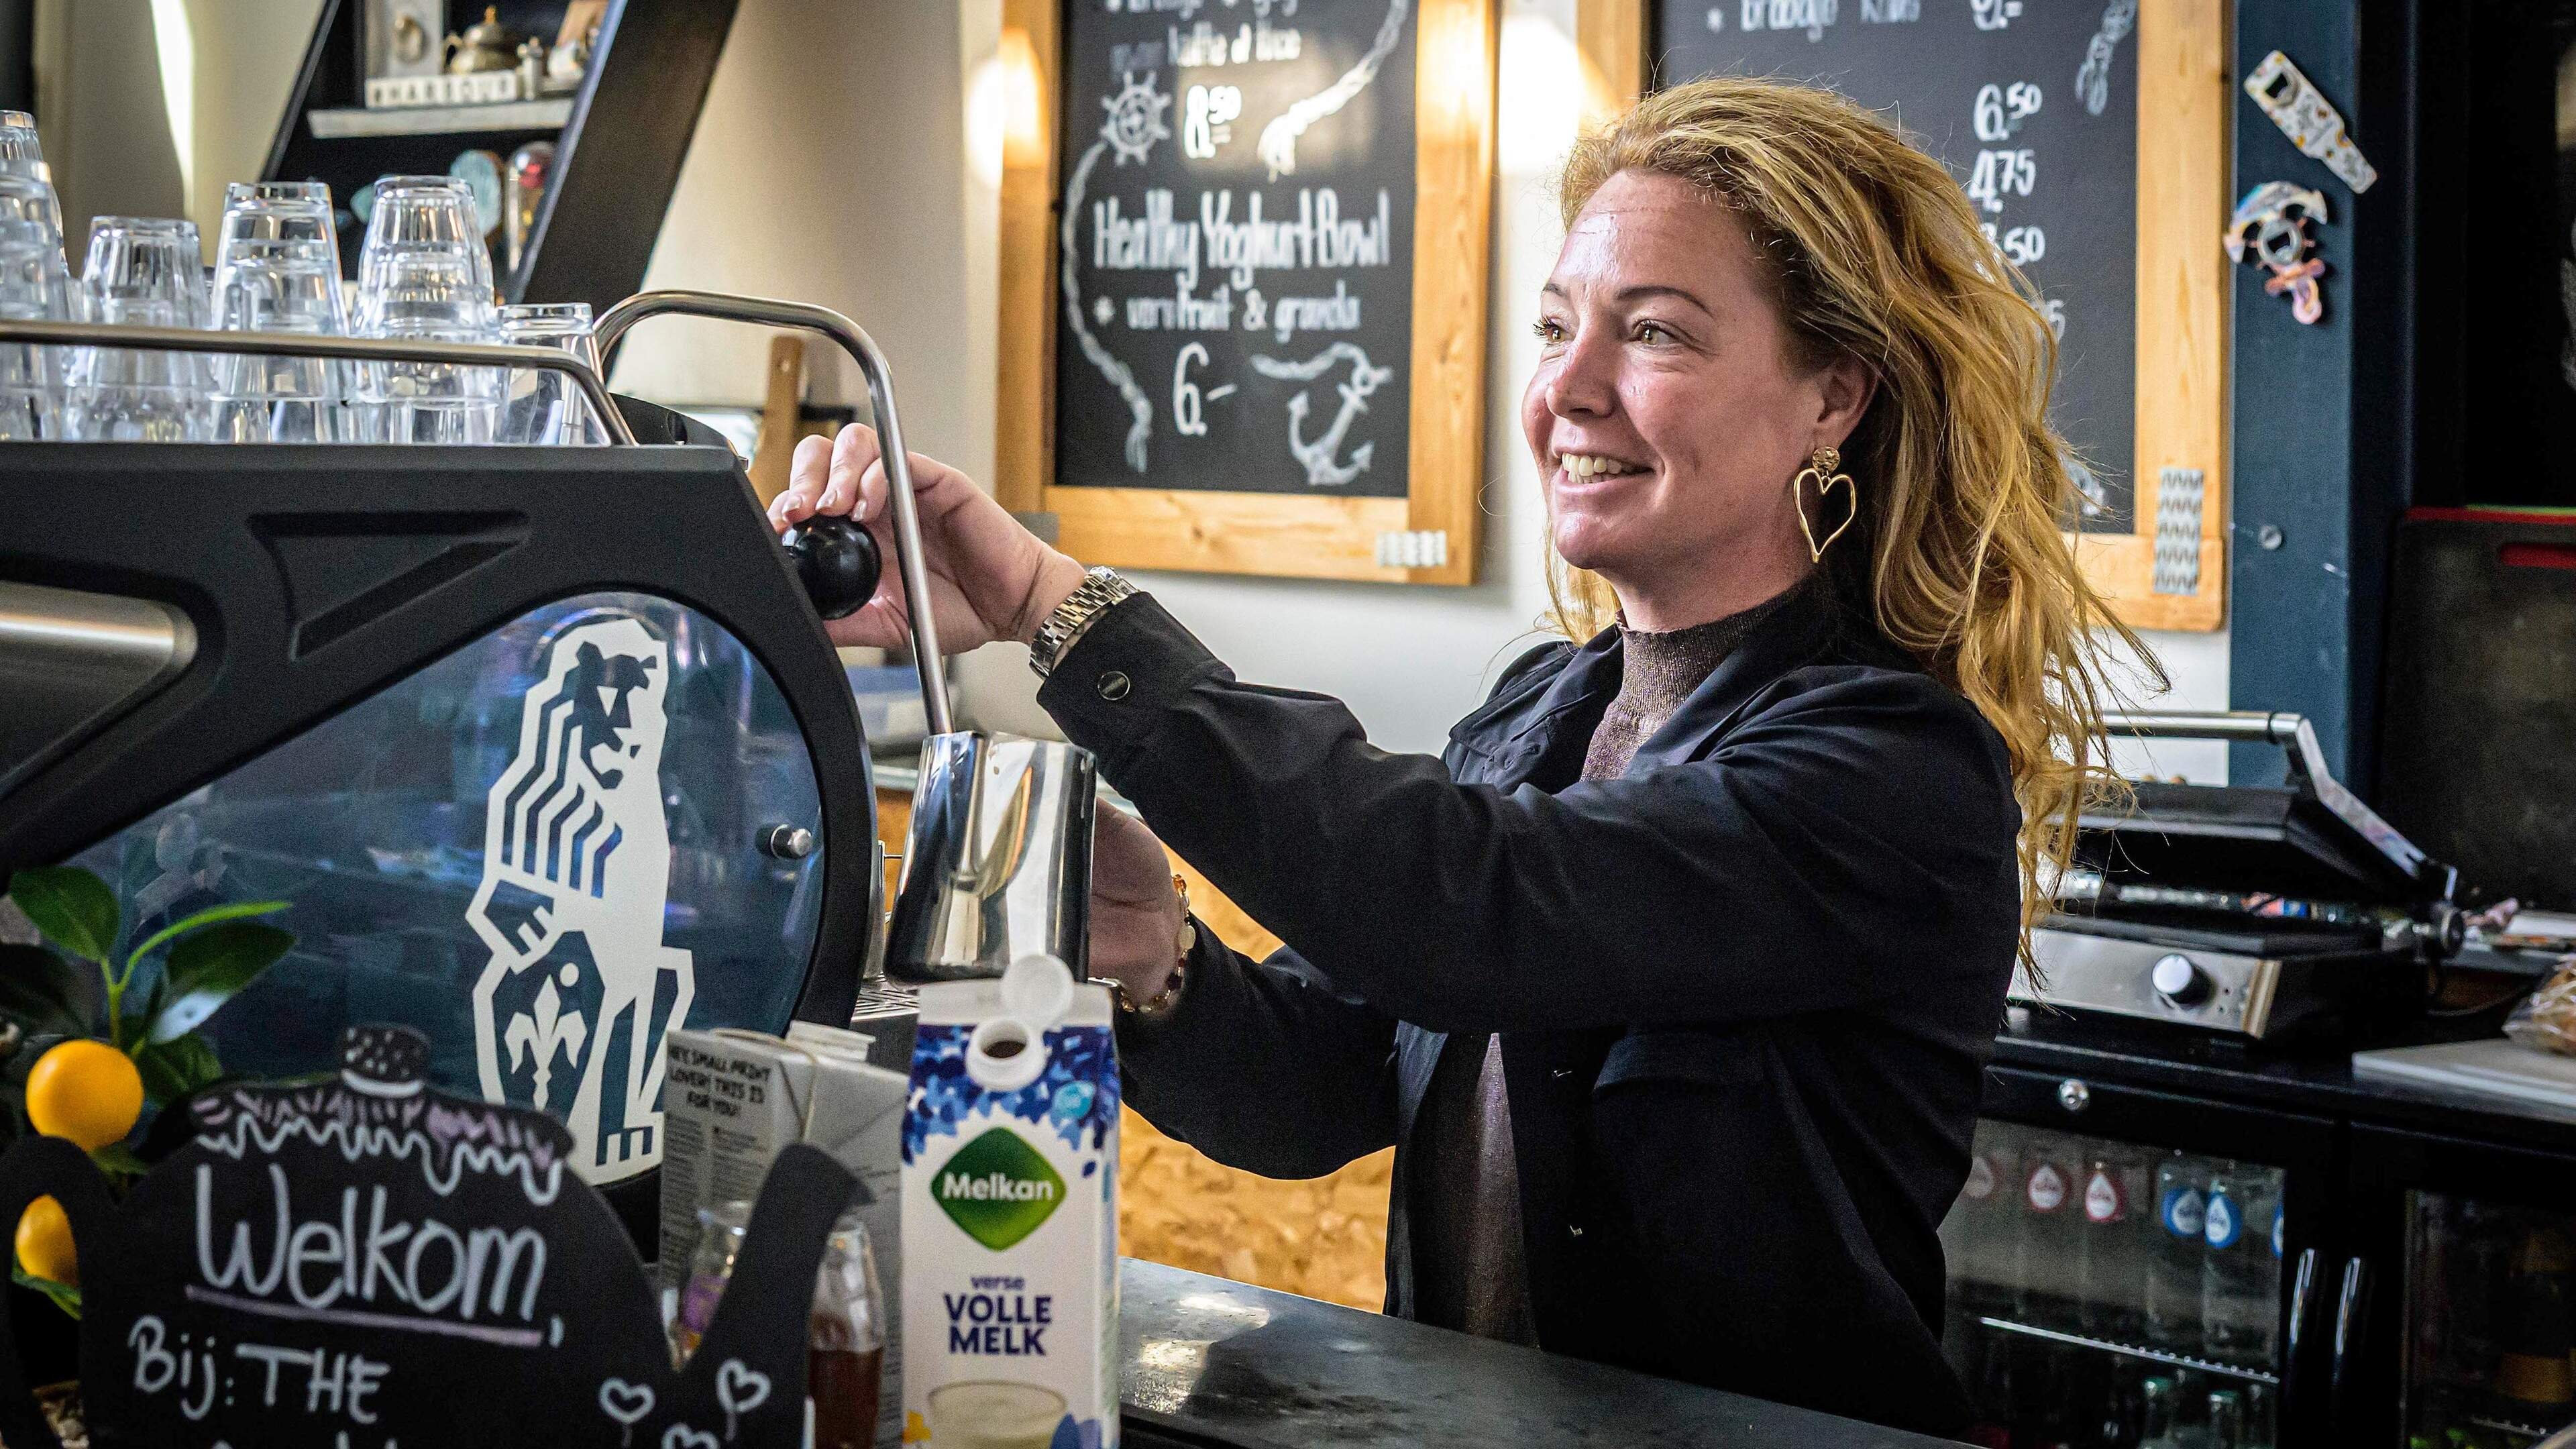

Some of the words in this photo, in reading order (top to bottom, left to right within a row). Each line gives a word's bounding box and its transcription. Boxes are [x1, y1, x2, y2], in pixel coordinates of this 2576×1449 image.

[1094, 189, 1199, 289] Healthy
[1201, 189, 1316, 290] Yoghurt
[1316, 188, 1391, 267] Bowl
[1242, 288, 1268, 331] &
[686, 1090, 709, 1108] FOR
[715, 1076, 745, 1100] THIS
[749, 1084, 765, 1104] IS
[943, 1171, 1053, 1201] Melkan
[971, 1277, 1026, 1291] verse
[943, 1292, 1052, 1324] VOLLE
[949, 1324, 1046, 1356] MELK
[235, 1343, 391, 1425] THE
